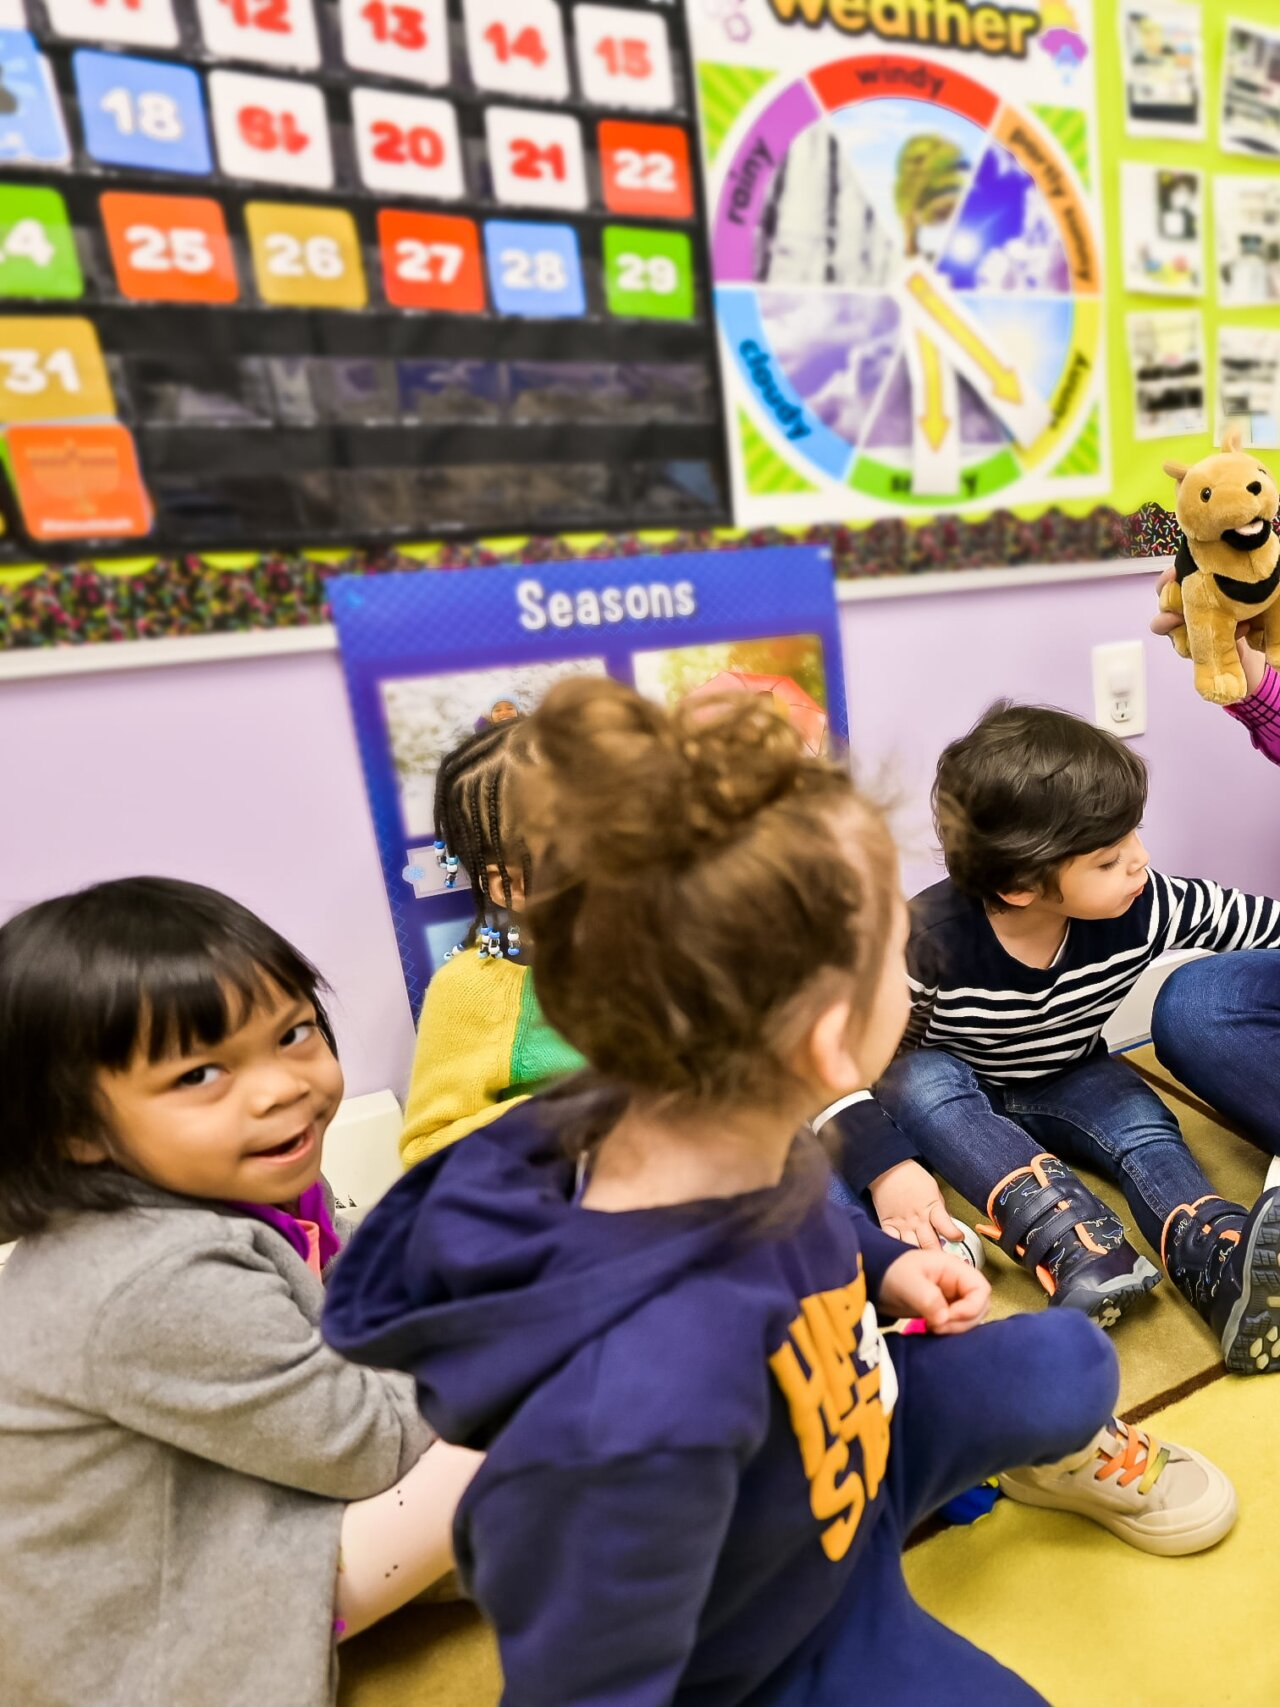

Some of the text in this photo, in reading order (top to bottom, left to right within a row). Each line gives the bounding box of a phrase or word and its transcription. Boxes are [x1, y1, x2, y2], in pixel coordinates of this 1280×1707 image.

[360, 0, 427, 51] 13
[484, 22, 547, 67] 14
[595, 36, 653, 80] 15
[855, 54, 944, 99] windy
[101, 86, 184, 141] 18
[369, 119, 445, 169] 20
[508, 137, 567, 183] 21
[612, 148, 677, 192] 22
[727, 136, 776, 226] rainy
[0, 218, 678, 294] 4 25 26 27 28 29
[0, 346, 81, 394] 31
[738, 339, 812, 441] cloudy
[516, 579, 696, 631] Seasons
